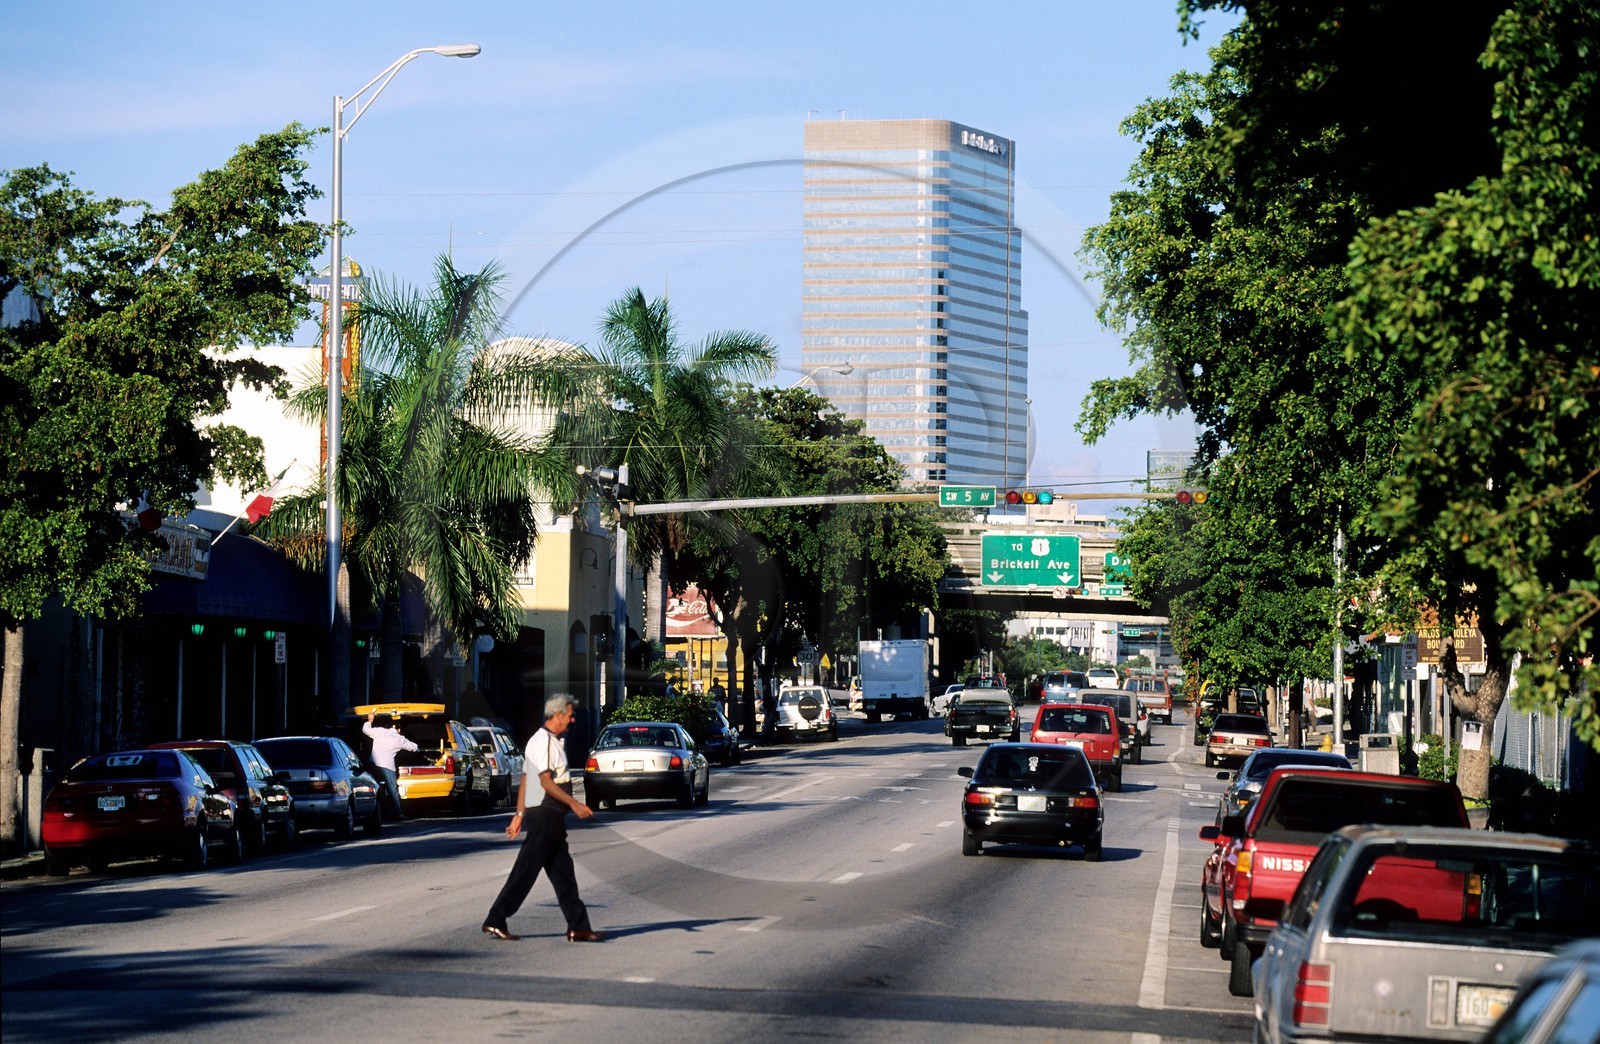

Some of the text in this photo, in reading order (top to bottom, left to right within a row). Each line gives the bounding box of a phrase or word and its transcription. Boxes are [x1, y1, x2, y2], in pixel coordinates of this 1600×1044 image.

[945, 491, 990, 502] SW 5 AV
[1011, 543, 1023, 551] TO
[991, 558, 1071, 569] Brickell Ave
[1415, 628, 1440, 638] ARLOS
